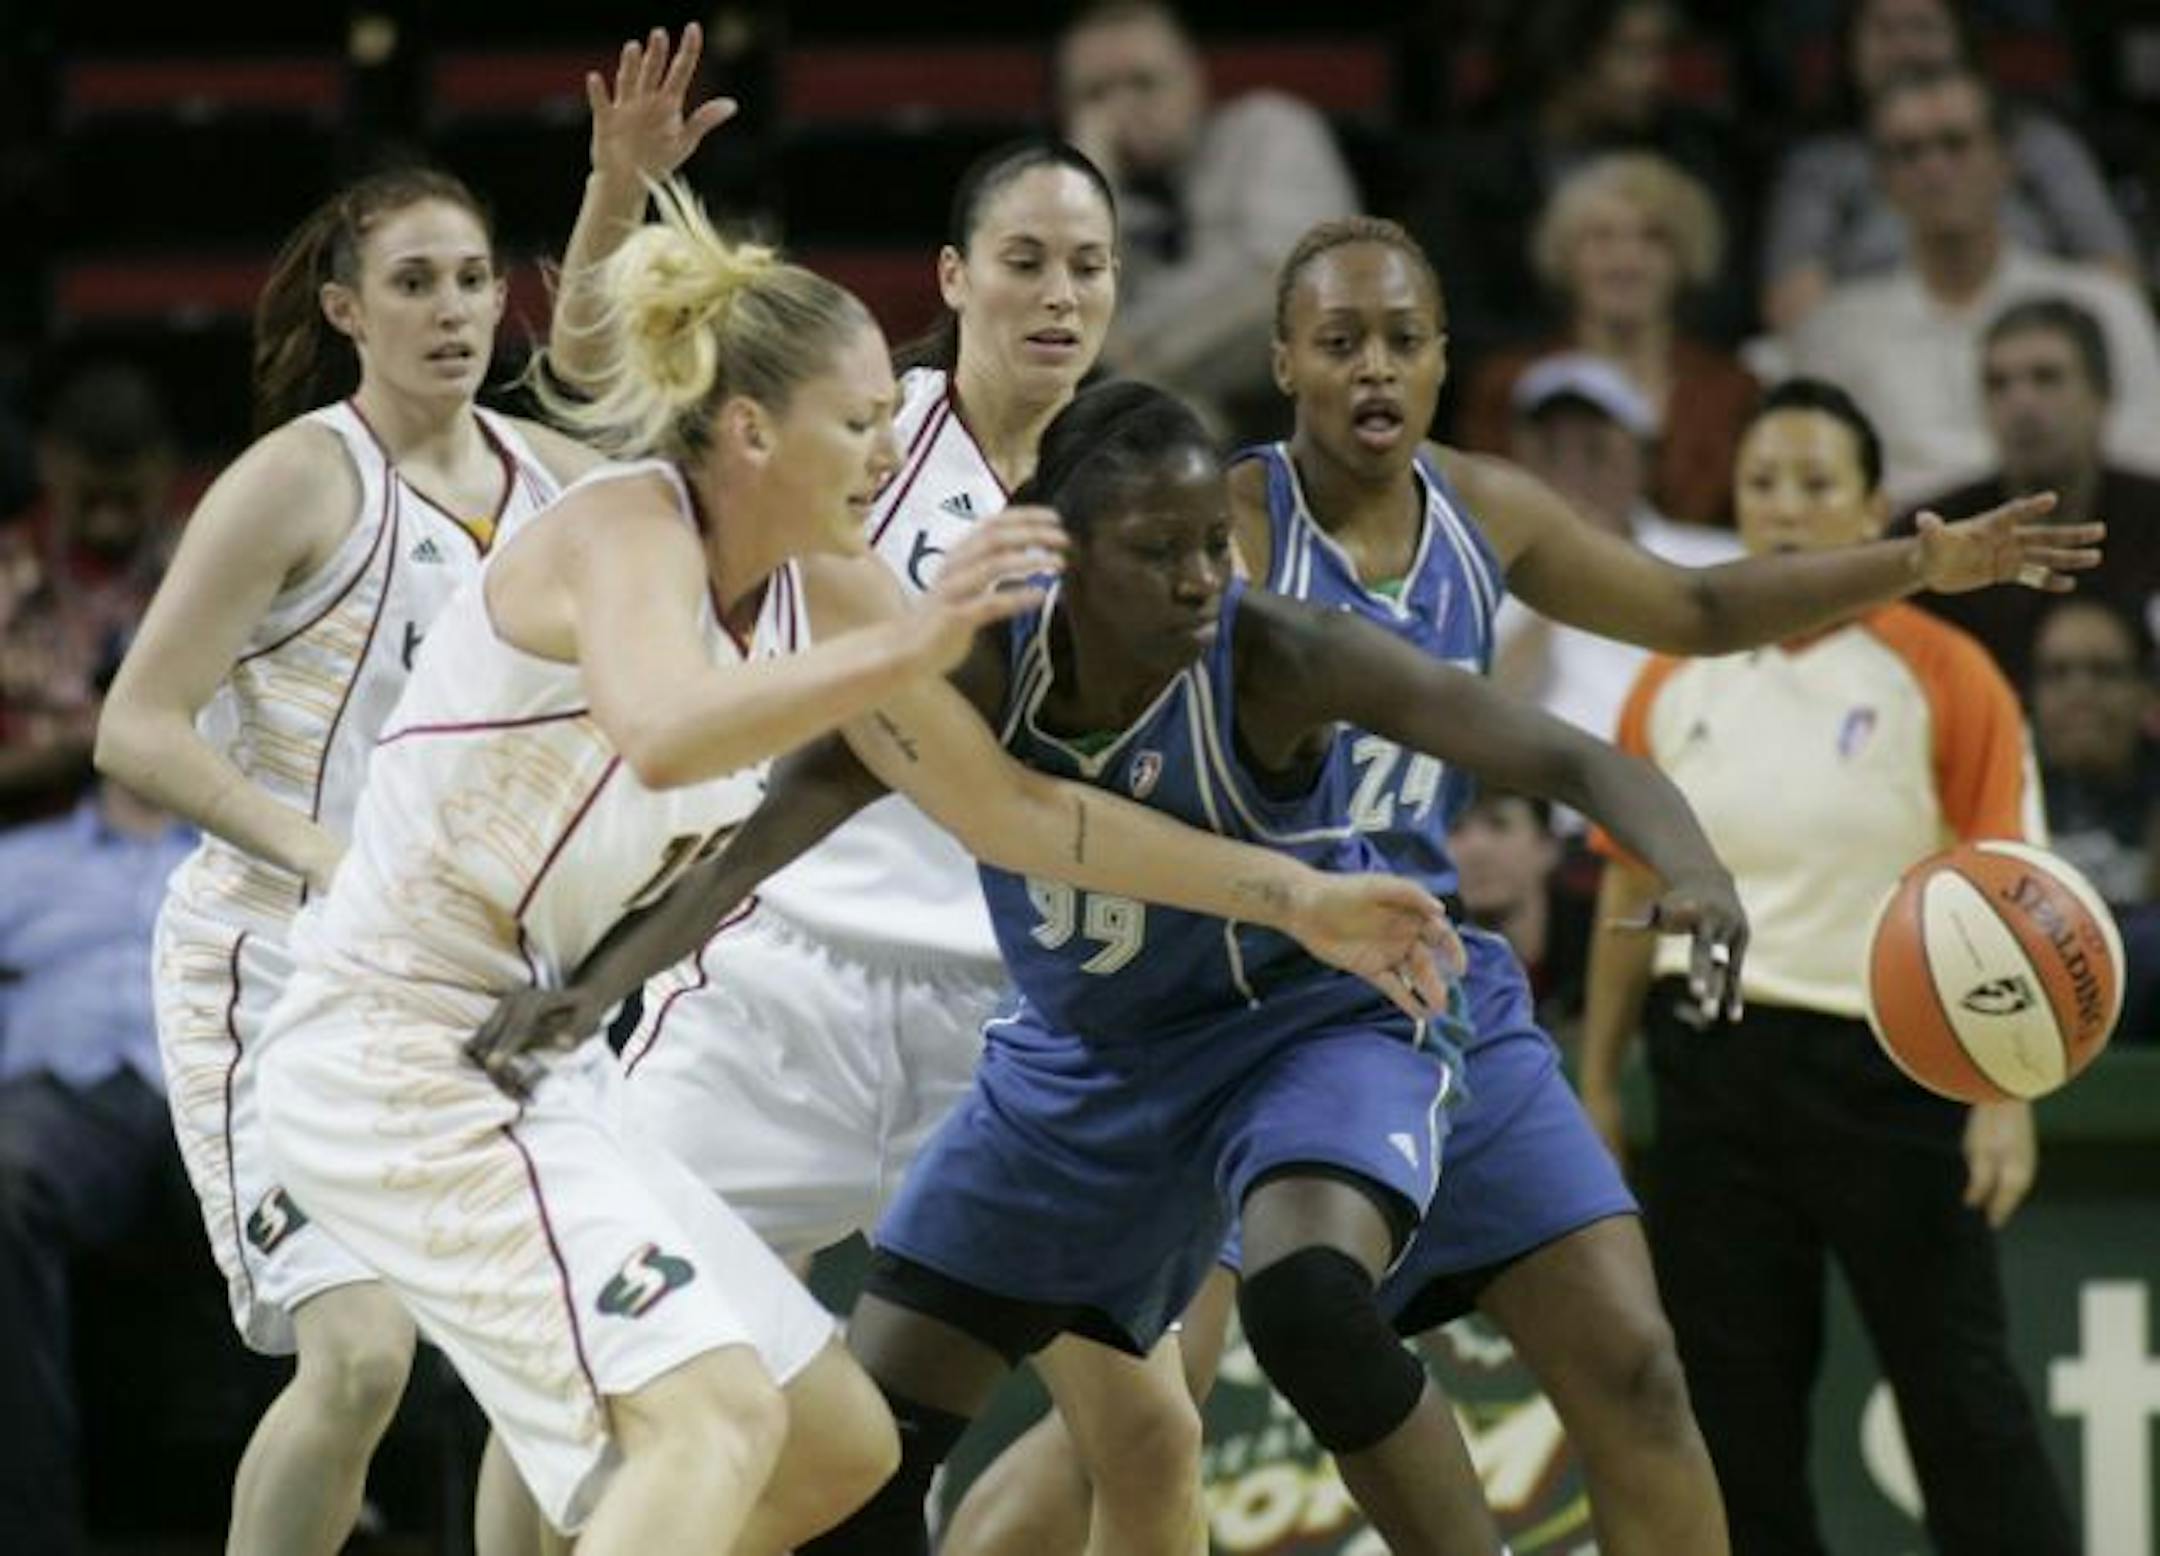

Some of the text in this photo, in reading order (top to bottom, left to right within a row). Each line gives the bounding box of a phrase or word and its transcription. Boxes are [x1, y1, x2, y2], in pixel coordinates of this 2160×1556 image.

[1348, 735, 1443, 833] 24
[1024, 875, 1147, 976] 99
[2001, 874, 2103, 1030] SPALDING
